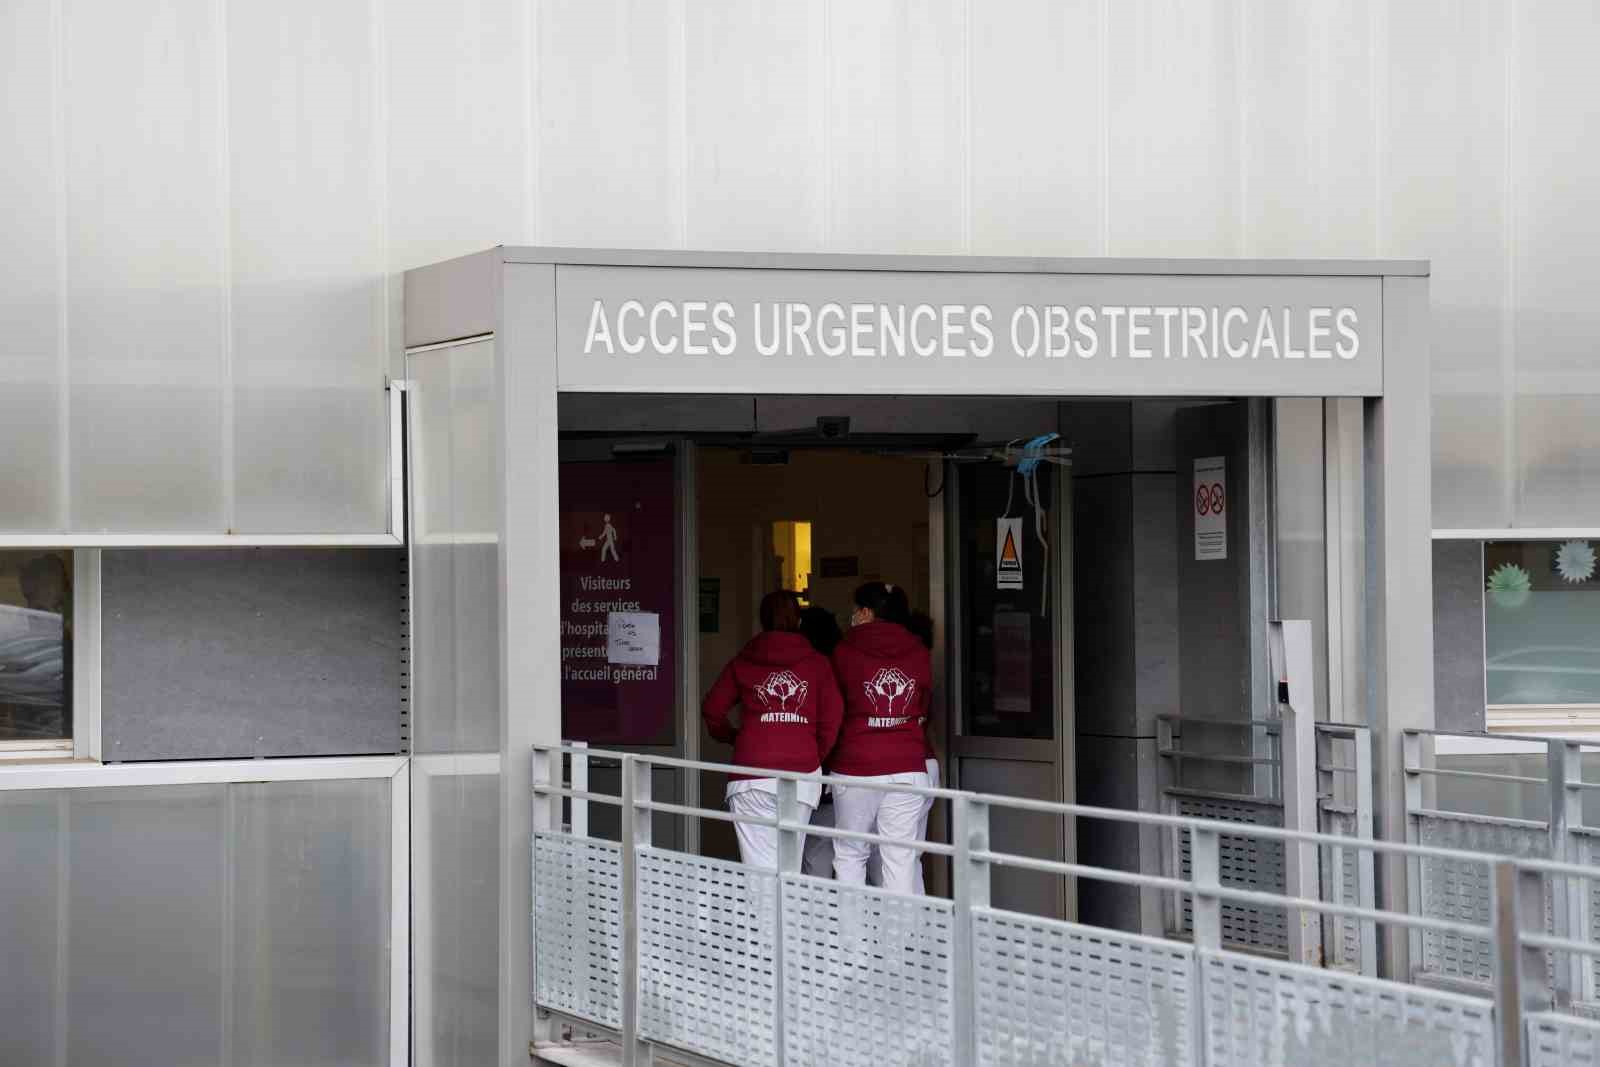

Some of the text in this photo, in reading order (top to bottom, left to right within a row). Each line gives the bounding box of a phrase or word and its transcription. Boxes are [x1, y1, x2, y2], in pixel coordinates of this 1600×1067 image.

[583, 300, 1360, 360] ACCES URGENCES OBSTETRICALES
[579, 576, 631, 590] Visiteurs
[571, 597, 641, 612] des services
[565, 664, 657, 684] l'accueil général
